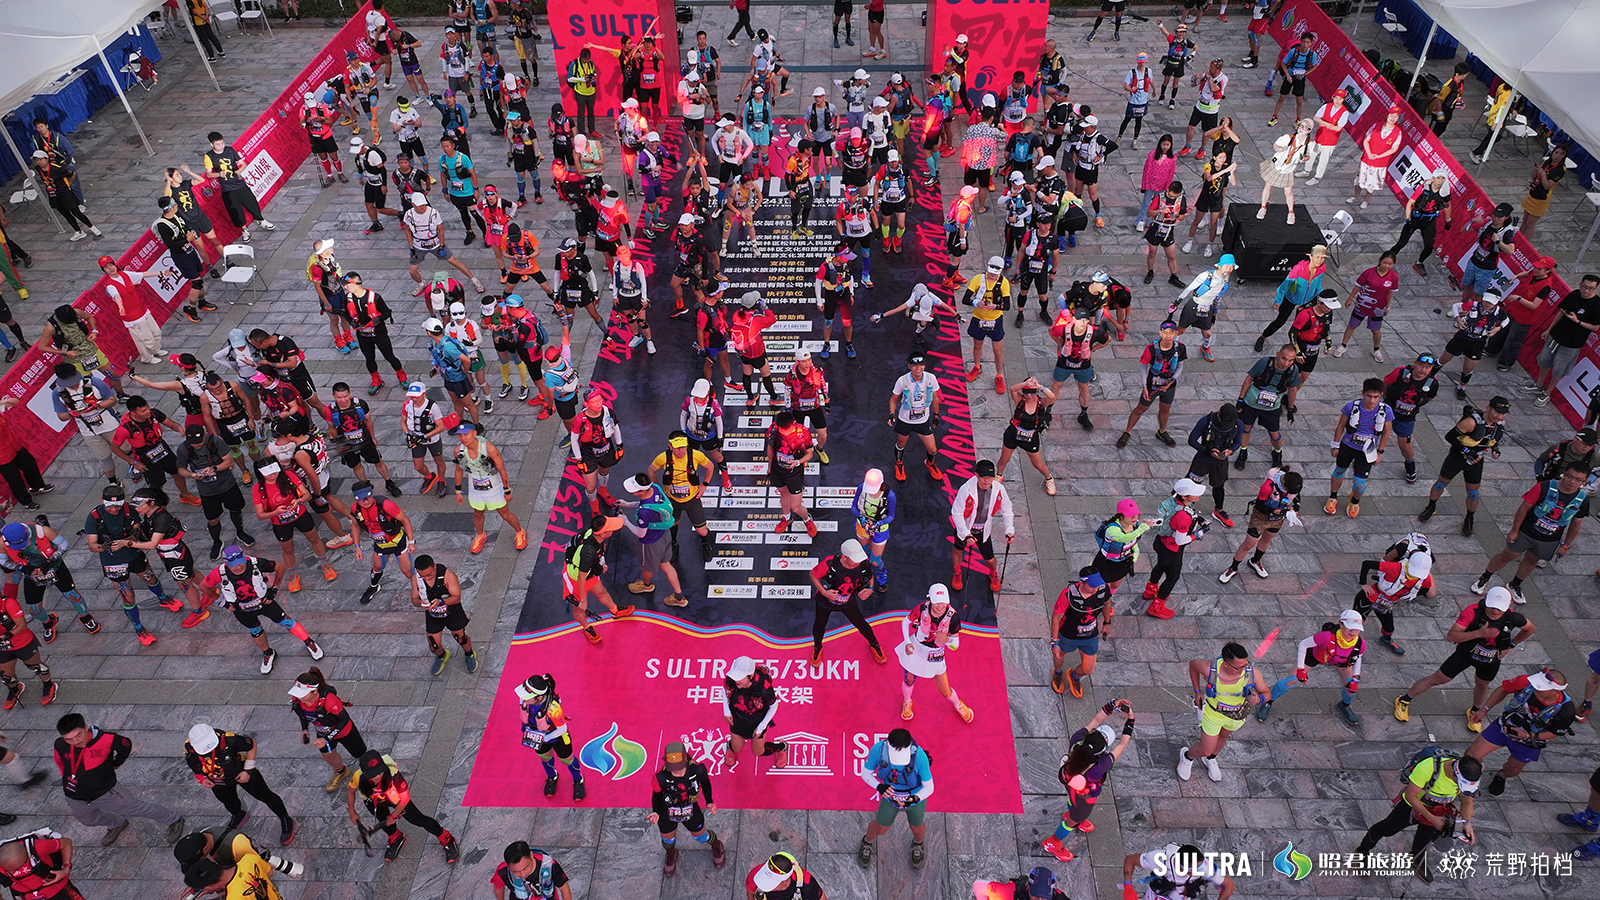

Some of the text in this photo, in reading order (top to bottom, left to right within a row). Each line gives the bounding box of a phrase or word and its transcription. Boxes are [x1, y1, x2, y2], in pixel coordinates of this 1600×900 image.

[569, 14, 586, 36] S
[915, 221, 950, 275] PARTY
[927, 351, 977, 479] MOUNTAIN
[645, 658, 860, 680] S ULTR 5/30KM
[687, 685, 814, 704] 中国农架
